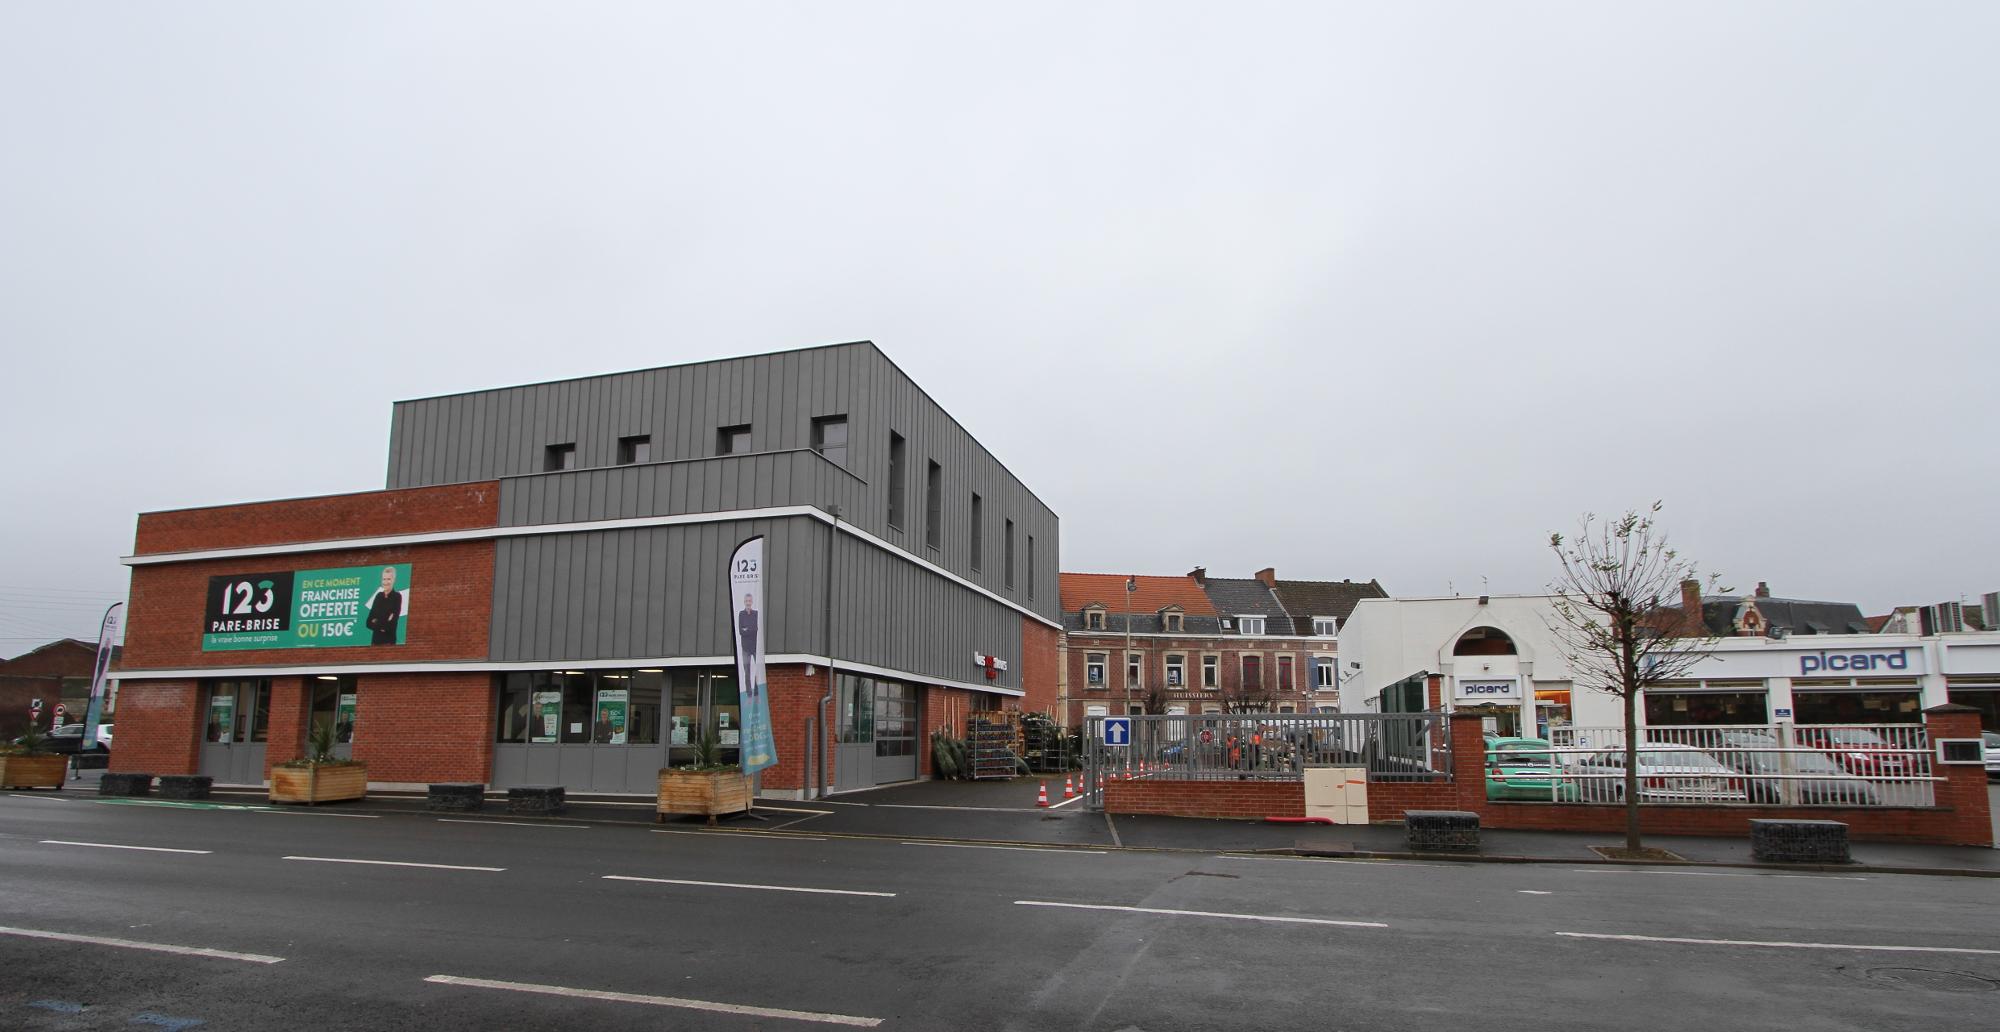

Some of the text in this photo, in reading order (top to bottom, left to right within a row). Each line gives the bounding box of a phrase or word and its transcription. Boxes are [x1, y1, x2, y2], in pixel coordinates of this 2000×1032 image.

[737, 559, 757, 573] 123
[302, 577, 361, 589] EN CE MOMENT
[222, 580, 274, 615] 123
[301, 588, 360, 602] FRANCHISE
[299, 601, 359, 617] OFFERTE
[212, 618, 280, 632] PARE-BRISE
[298, 623, 319, 638] OU
[1800, 649, 1907, 675] picard
[1465, 683, 1510, 695] picard
